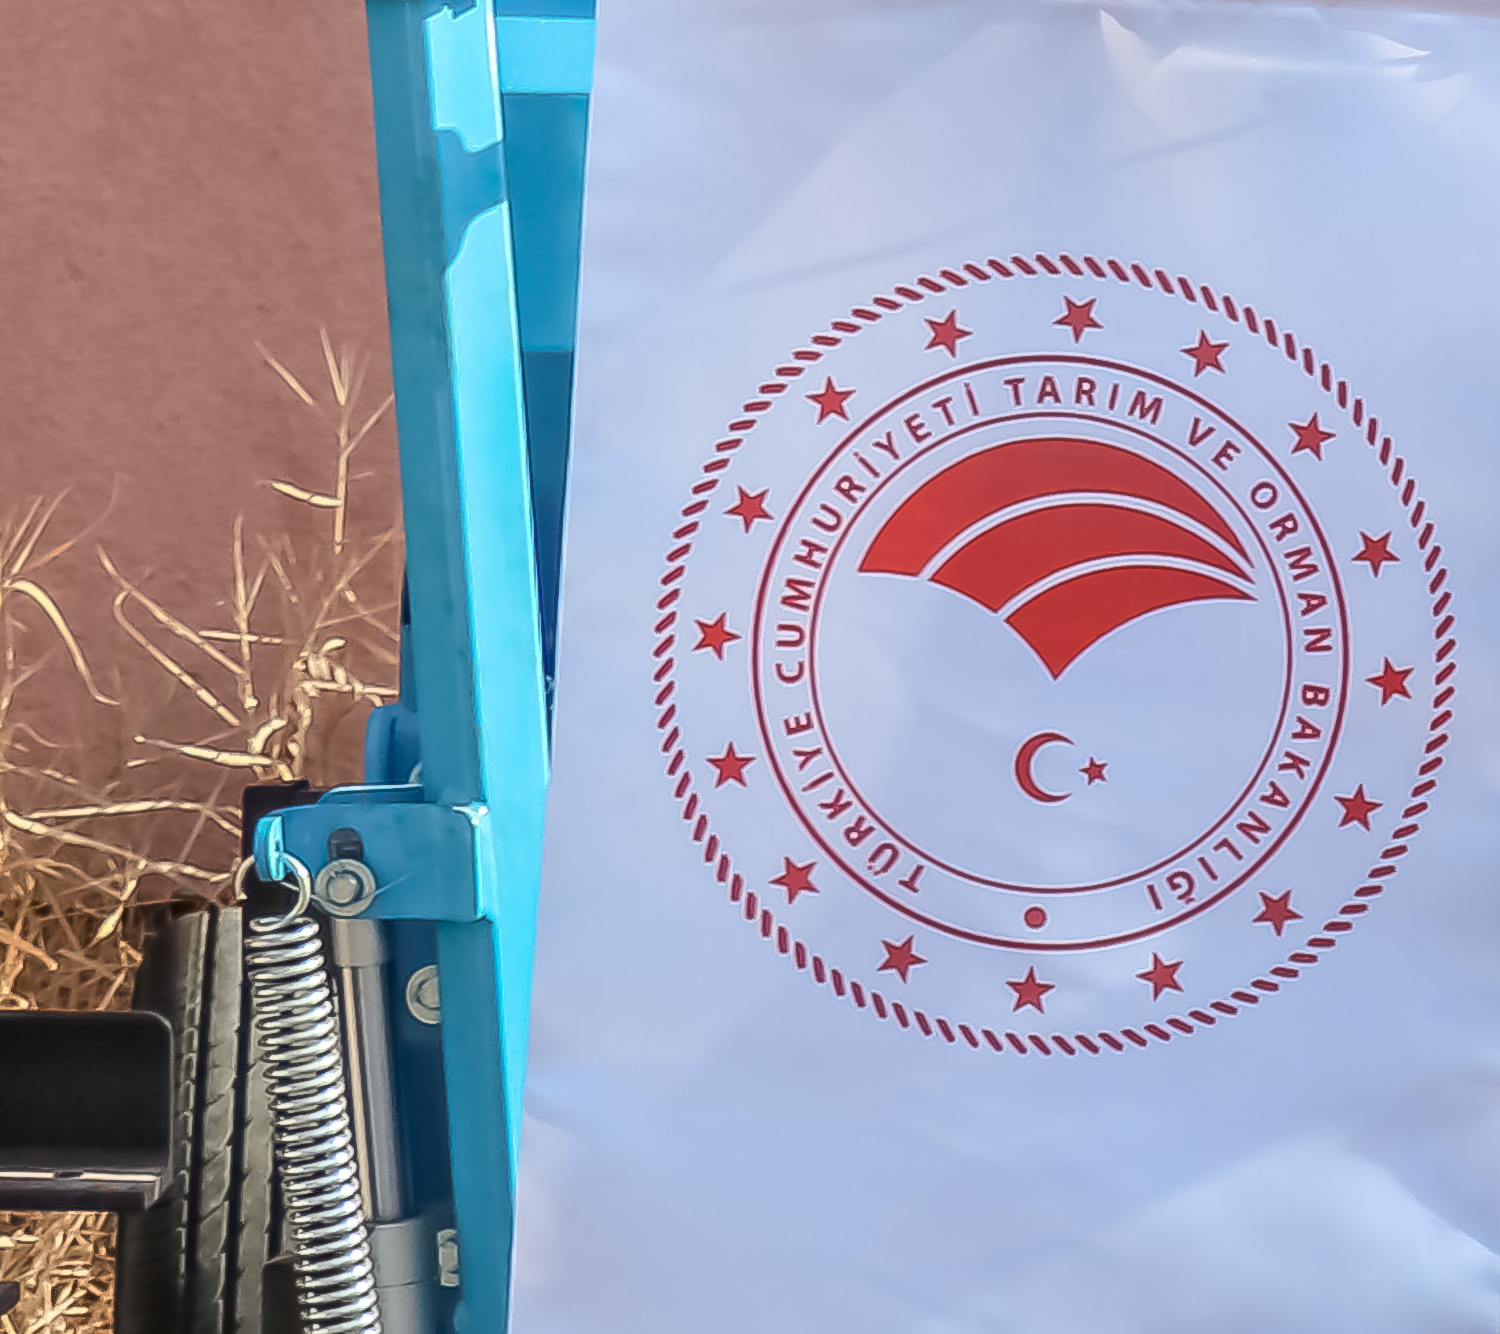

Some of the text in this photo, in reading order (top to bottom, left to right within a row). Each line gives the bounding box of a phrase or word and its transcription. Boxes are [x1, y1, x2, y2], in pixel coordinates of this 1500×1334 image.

[774, 374, 1334, 912] TÜRKİYE CUMHURİYETİ TARIM VE ORMAN BAKANLIĞI
